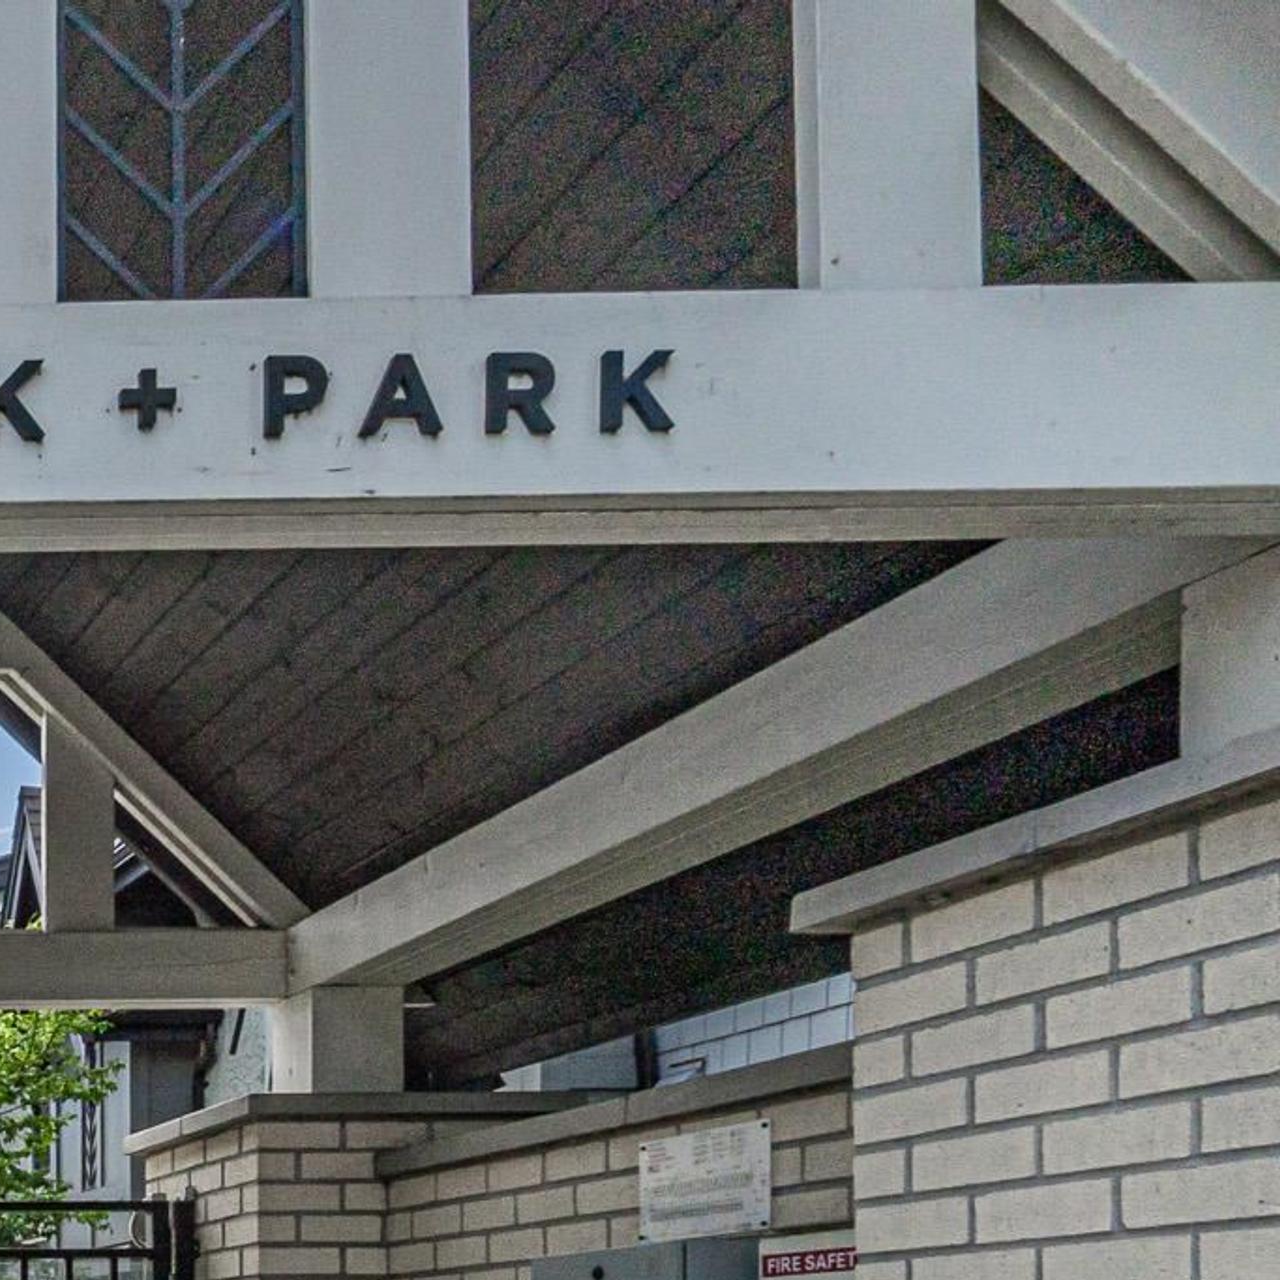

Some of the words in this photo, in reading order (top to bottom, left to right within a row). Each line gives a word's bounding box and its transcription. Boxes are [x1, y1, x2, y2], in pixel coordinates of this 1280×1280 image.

[118, 368, 178, 431] +
[262, 349, 677, 440] PARK
[767, 1255, 801, 1274] FIRE
[804, 1251, 857, 1271] SAFET
